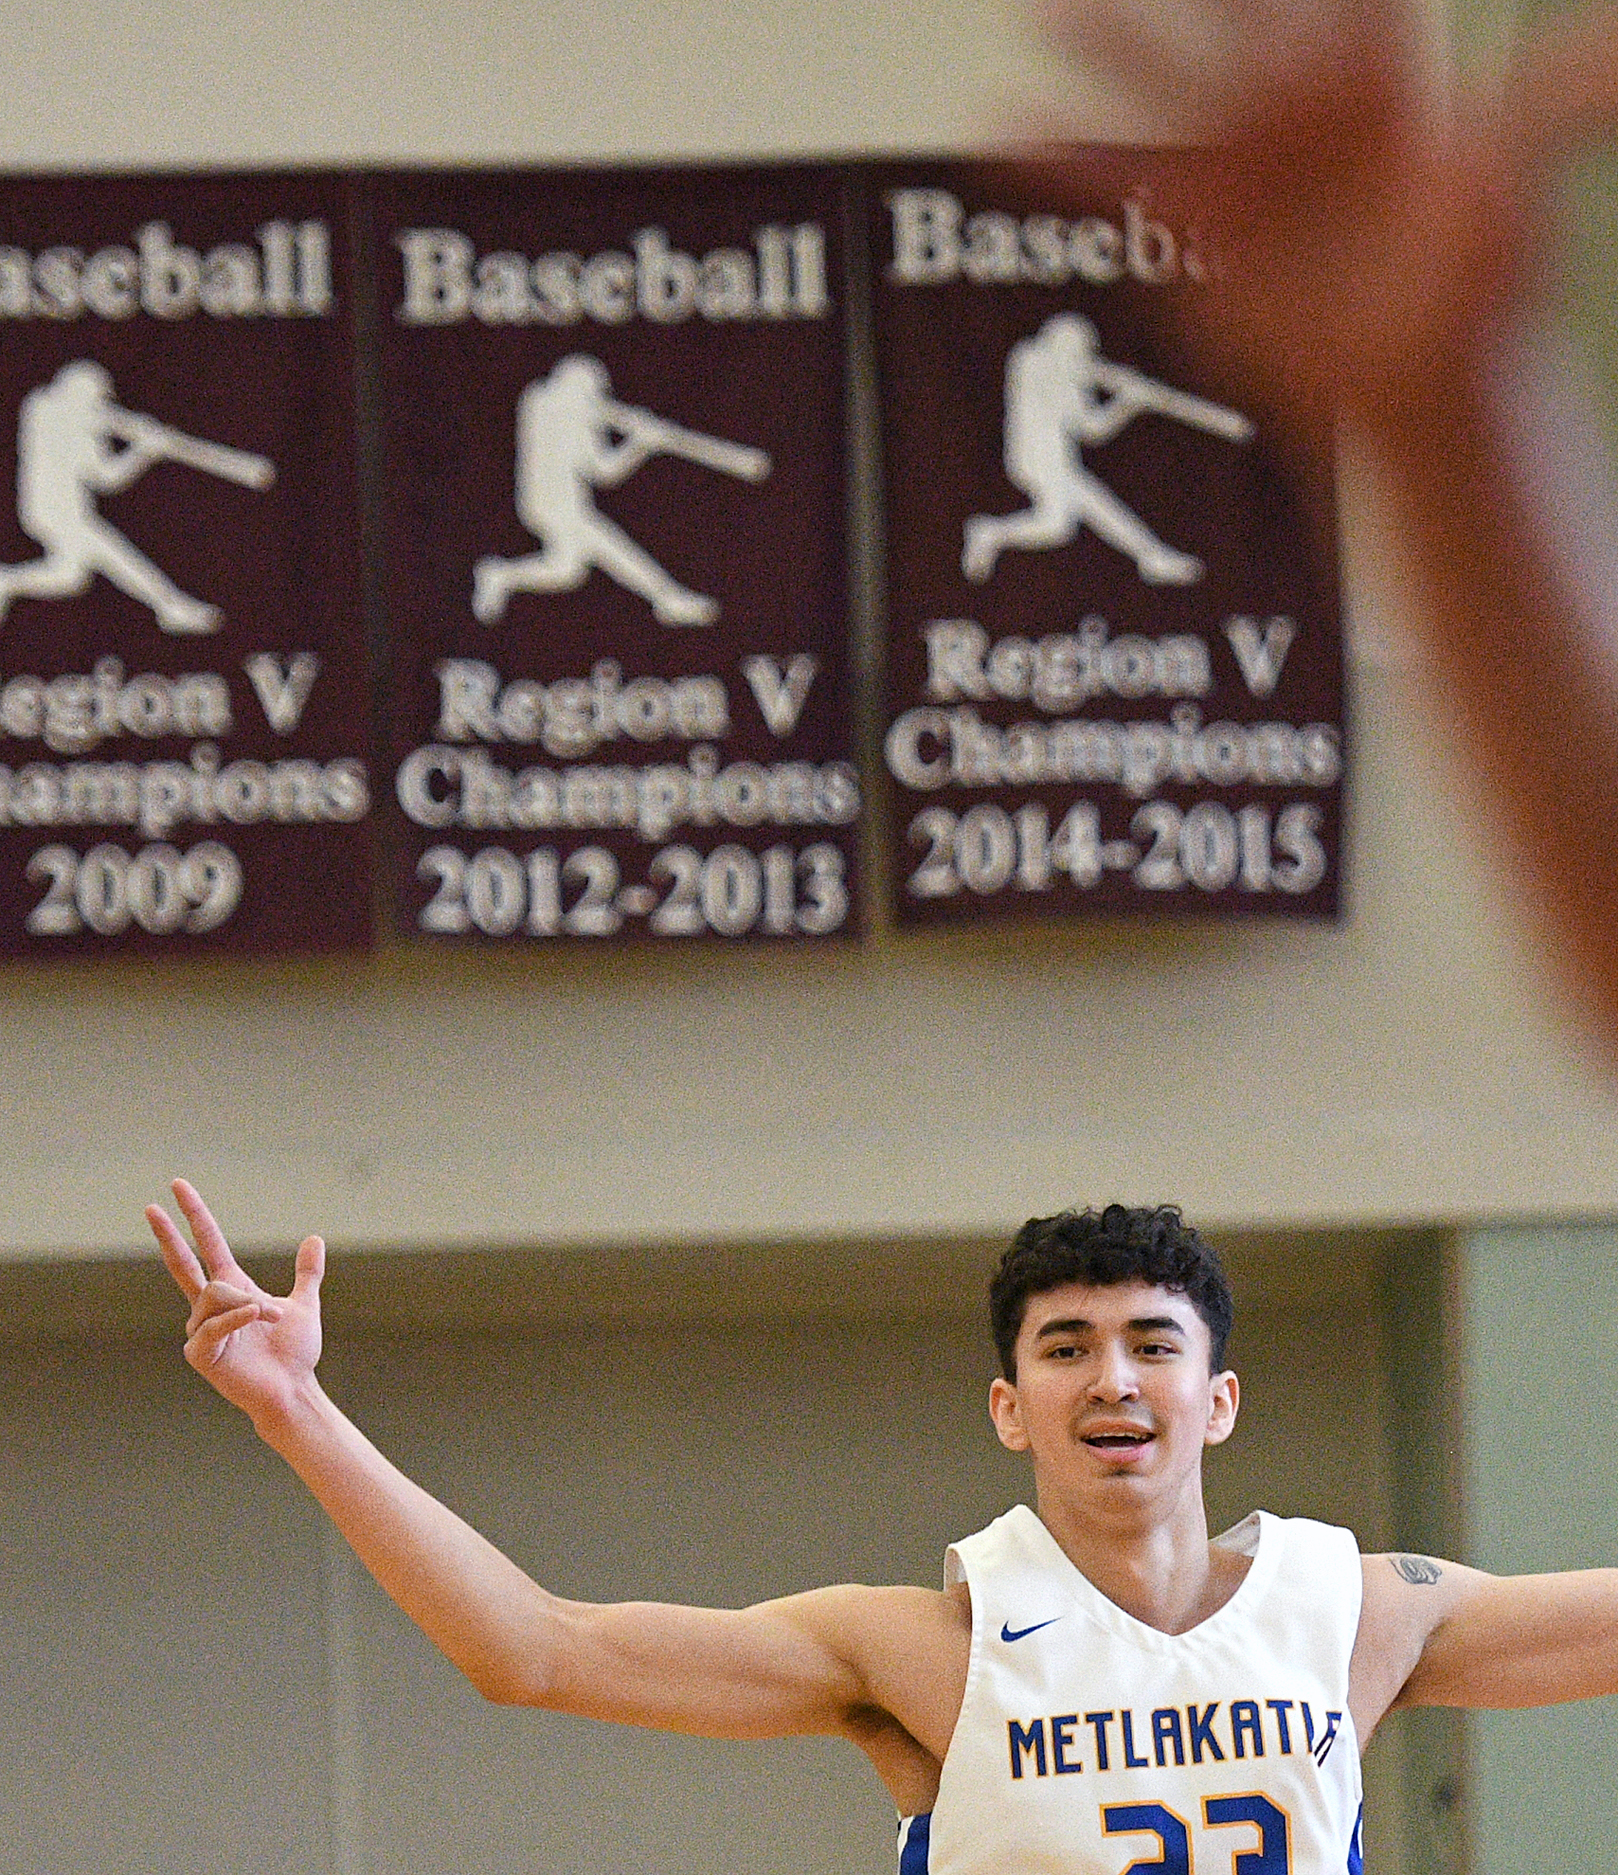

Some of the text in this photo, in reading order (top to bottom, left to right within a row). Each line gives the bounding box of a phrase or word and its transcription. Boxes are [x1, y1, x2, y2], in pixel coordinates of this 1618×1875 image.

[398, 225, 830, 325] Baseball
[244, 651, 320, 736] V
[436, 652, 818, 757] Region V
[922, 613, 1298, 711] Region V
[0, 740, 370, 840] ampions
[397, 741, 863, 842] Champions
[884, 702, 1342, 797] Champions
[25, 842, 244, 936] 2009
[416, 843, 850, 938] 2012-2013
[906, 800, 1329, 897] 2014-2015
